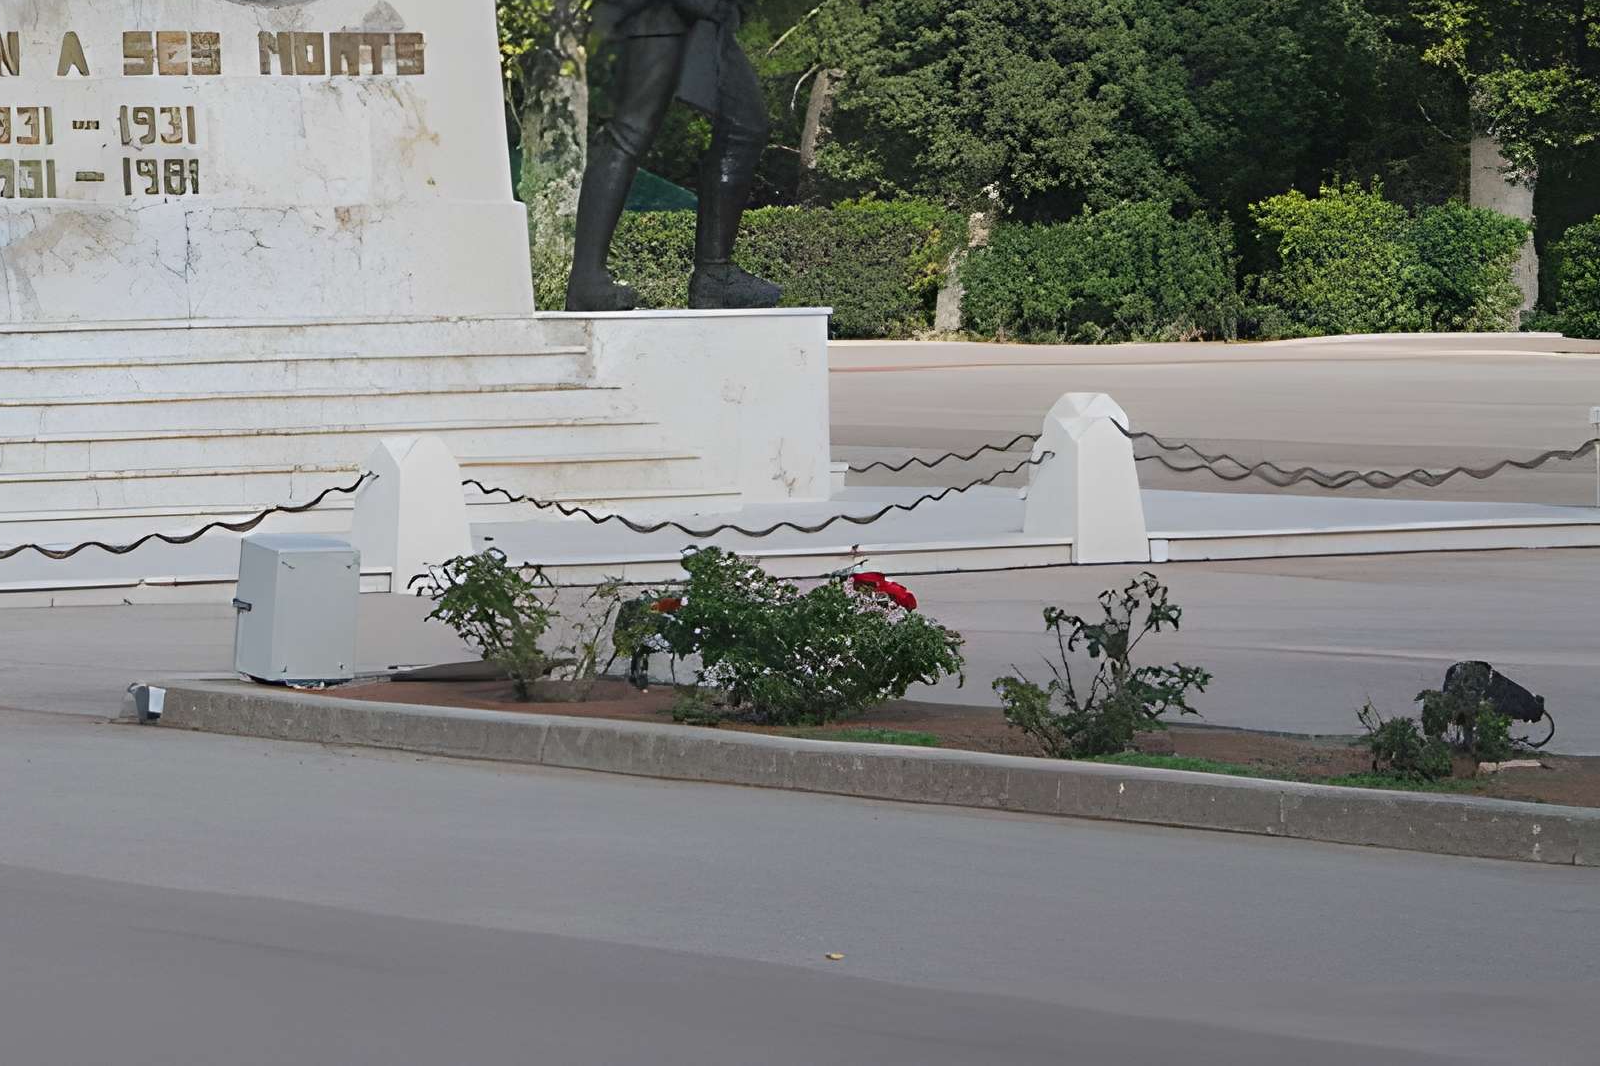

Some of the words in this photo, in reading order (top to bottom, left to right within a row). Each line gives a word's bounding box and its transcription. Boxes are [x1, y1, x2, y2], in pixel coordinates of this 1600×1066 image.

[57, 31, 90, 76] A
[122, 31, 221, 76] SES
[119, 105, 197, 146] 1931
[122, 157, 199, 196] 1981
